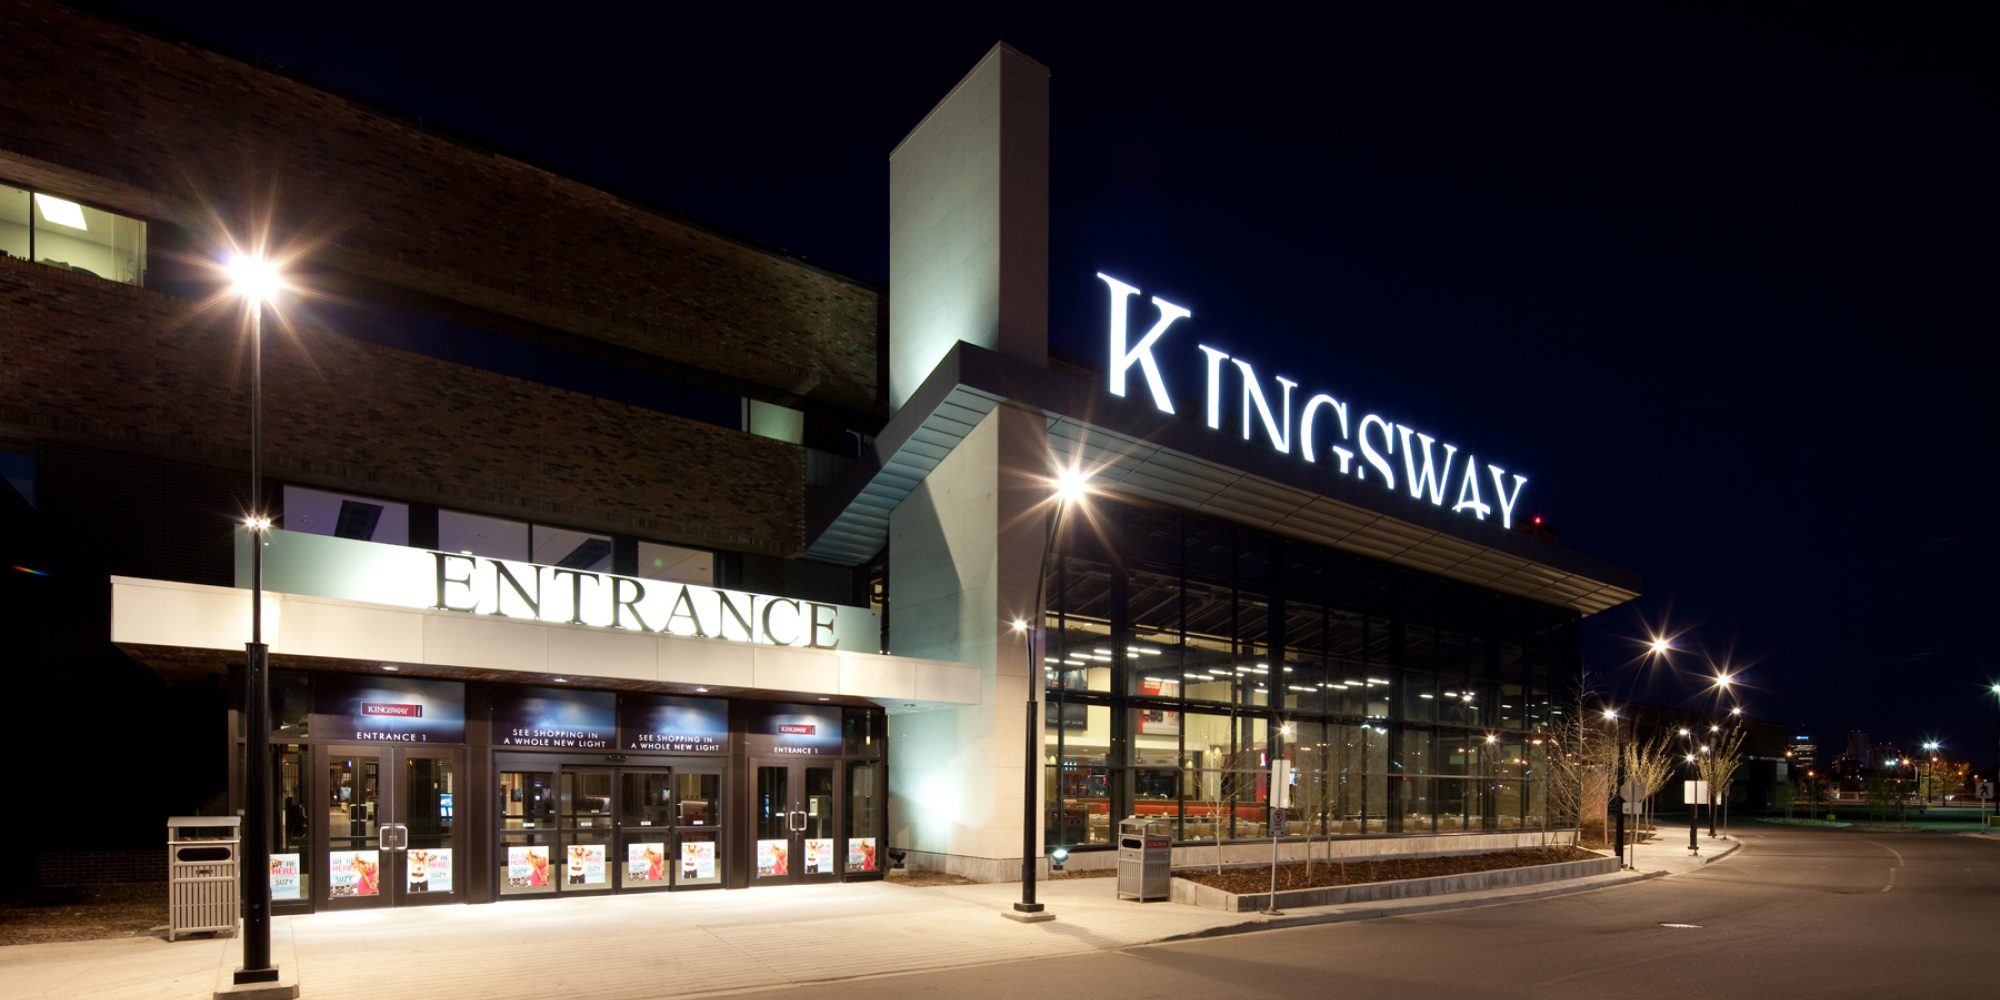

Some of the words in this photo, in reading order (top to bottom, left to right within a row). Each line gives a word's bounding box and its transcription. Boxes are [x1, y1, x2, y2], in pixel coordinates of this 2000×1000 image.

[1097, 272, 1527, 529] KINGSWAY
[427, 550, 839, 650] ENTRANCE
[368, 705, 409, 714] KINGSWAY
[356, 732, 416, 742] ENTRANCE
[512, 729, 530, 737] SEE
[534, 729, 584, 739] SHOPPING
[514, 738, 550, 746] WHOLE
[554, 739, 574, 747] NEW
[579, 740, 606, 748] LIGHT
[657, 735, 700, 743] SHOPPING
[696, 744, 720, 752] LIGHT
[774, 746, 811, 754] ENTRANCE
[335, 875, 353, 883] SUZY
